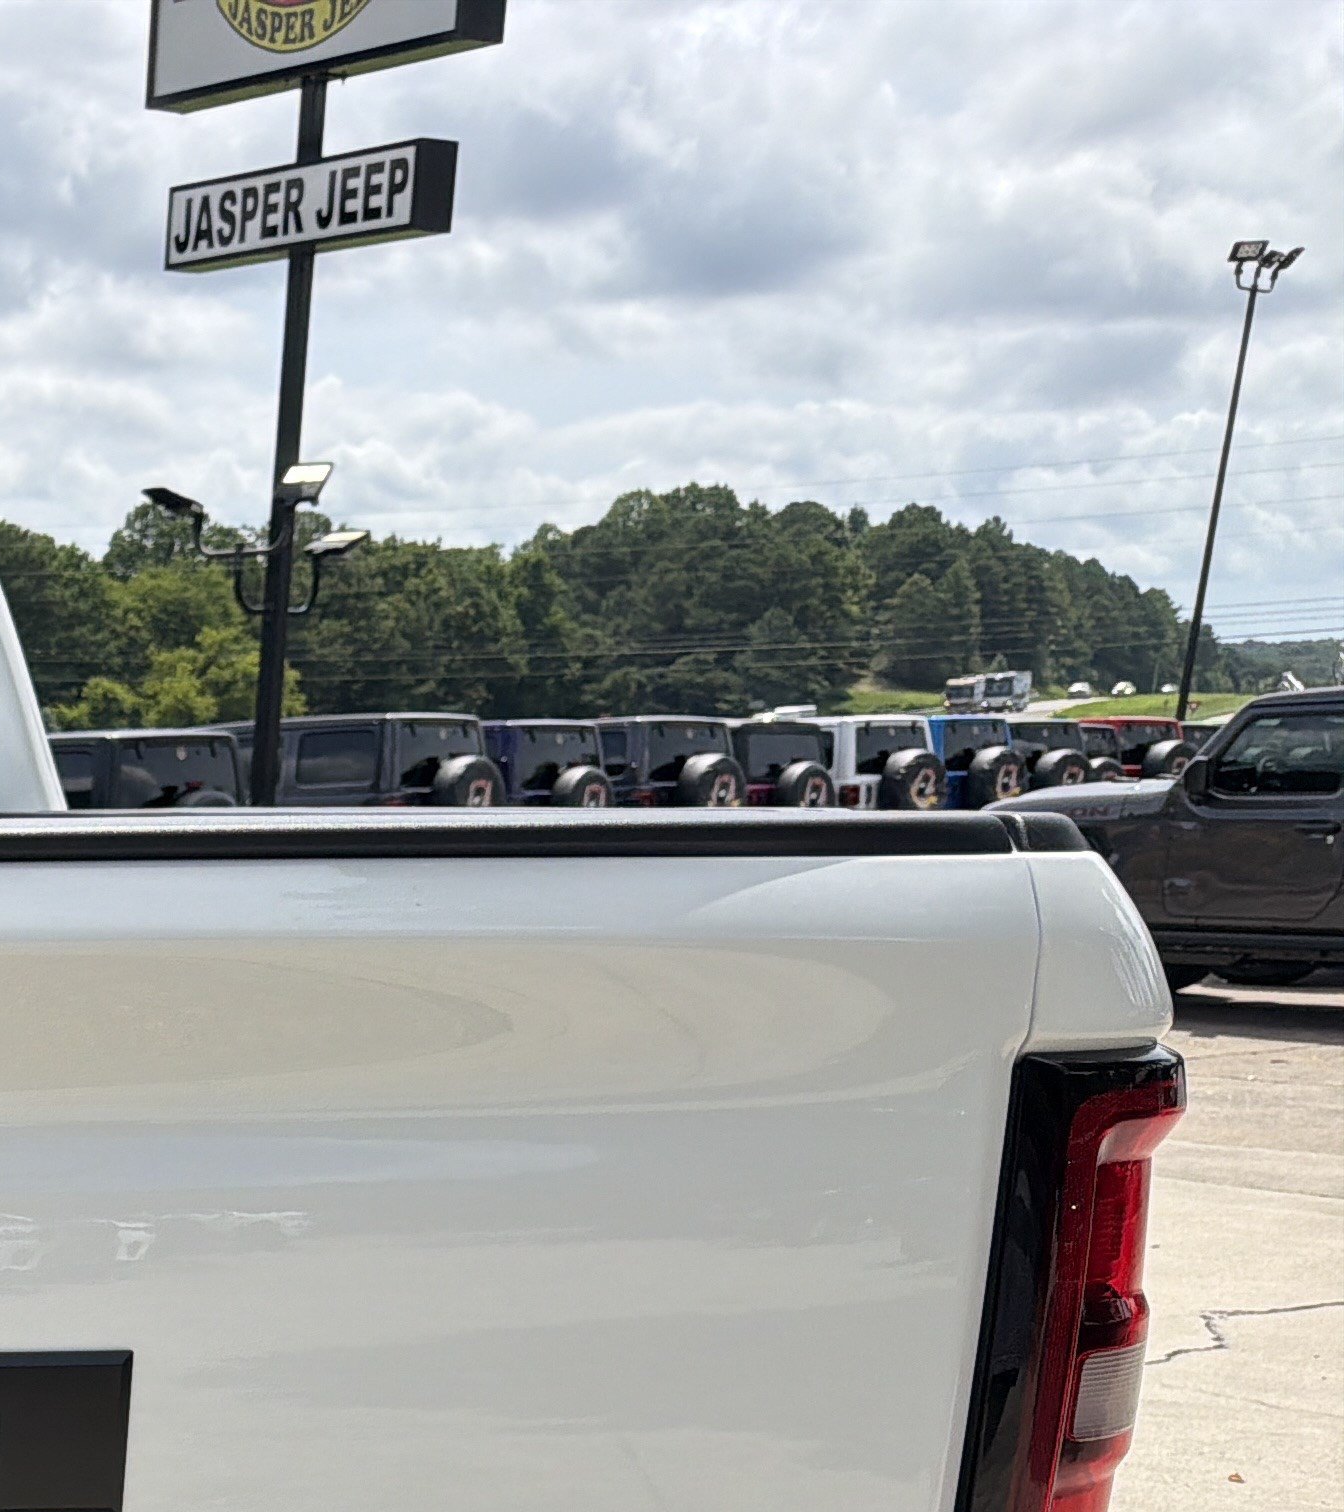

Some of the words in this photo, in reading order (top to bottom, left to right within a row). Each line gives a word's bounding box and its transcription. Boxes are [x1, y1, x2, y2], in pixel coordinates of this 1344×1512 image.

[227, 0, 316, 44] JASPER
[174, 177, 304, 254] JASPER
[316, 157, 409, 230] JEEP
